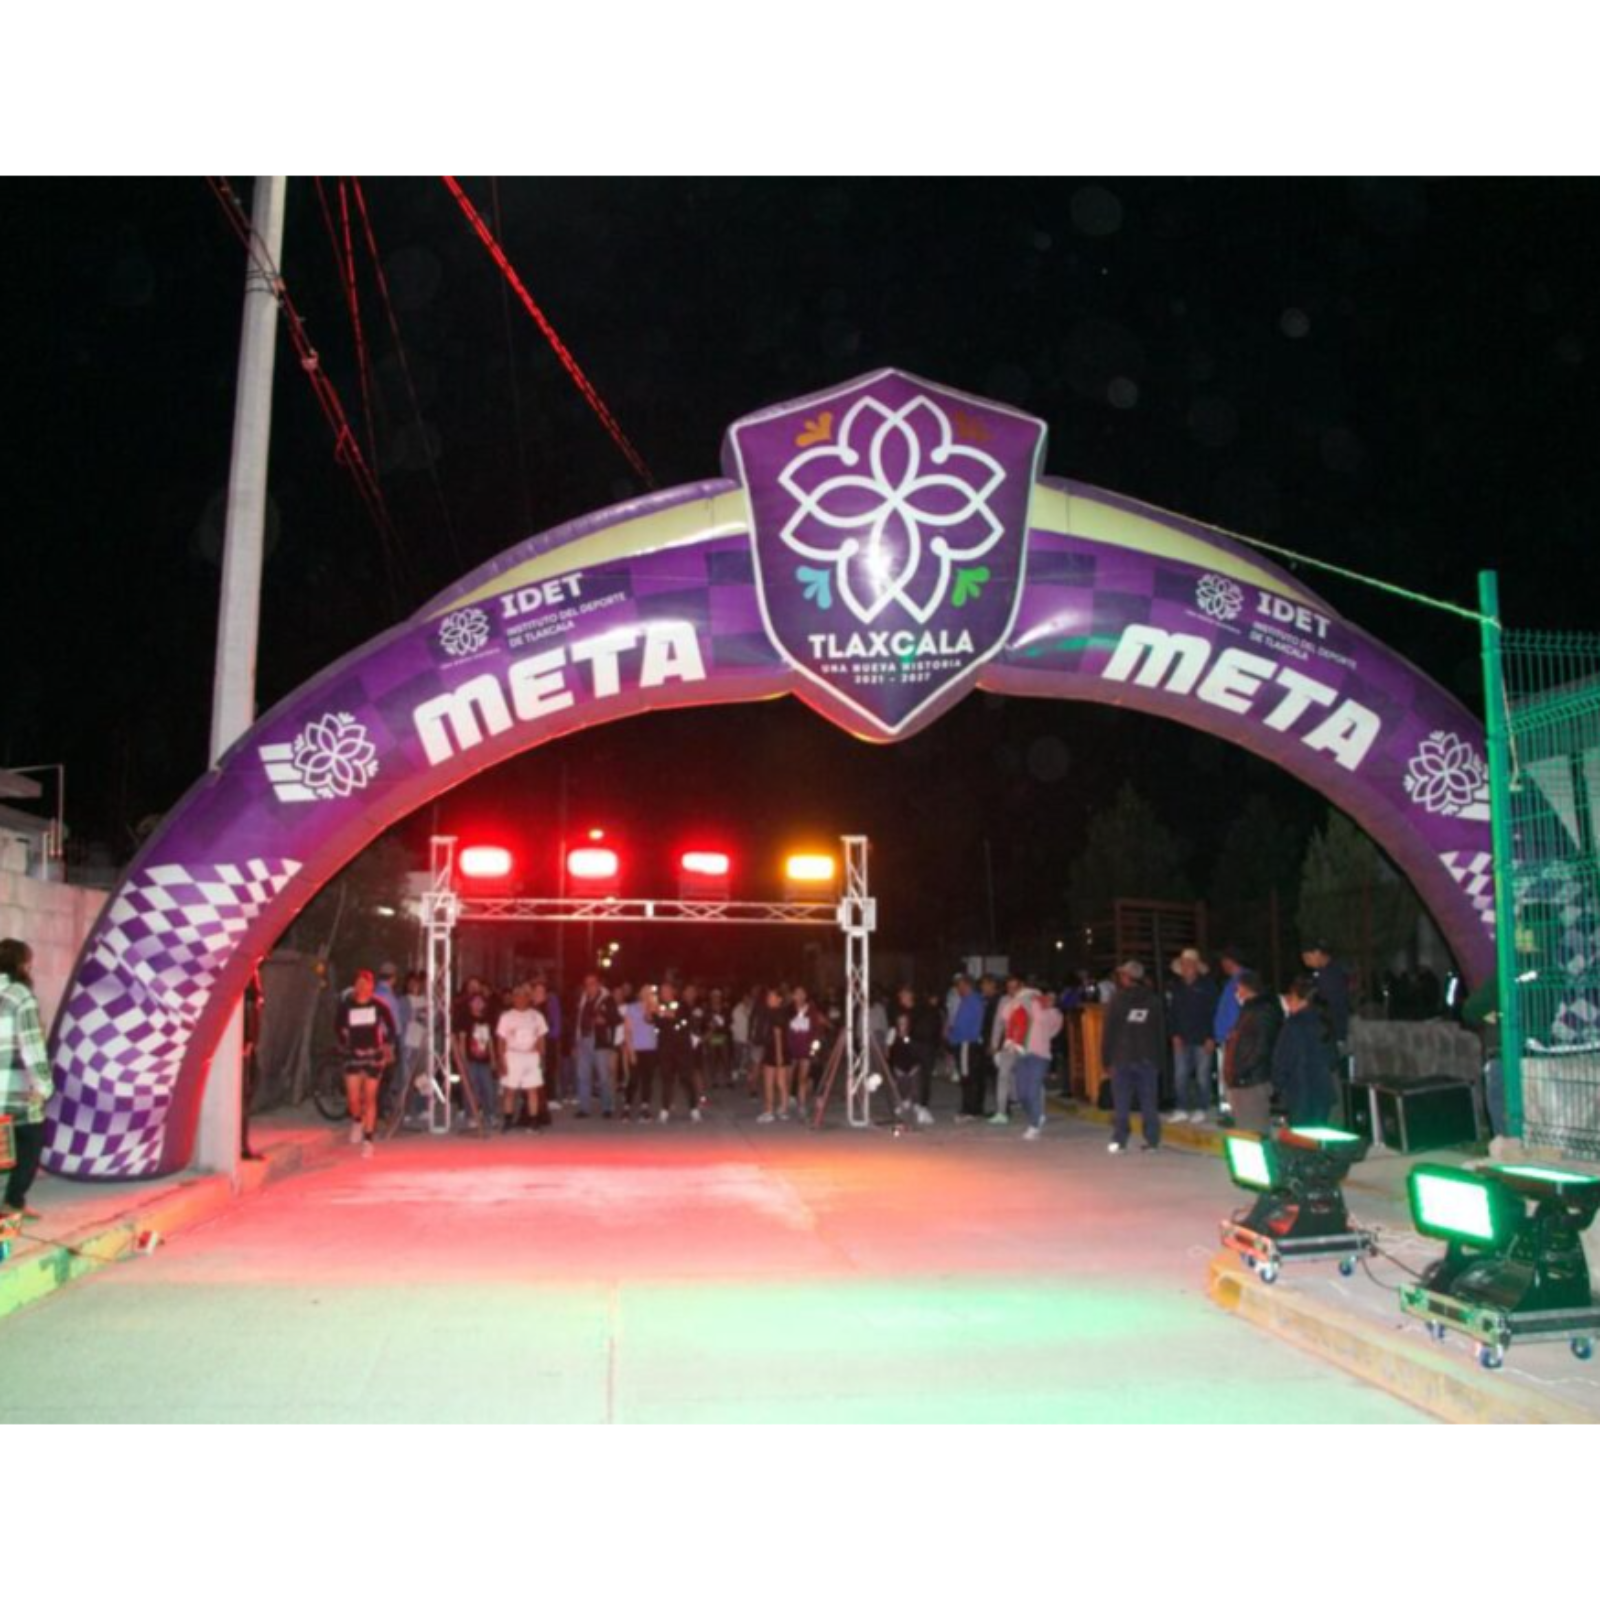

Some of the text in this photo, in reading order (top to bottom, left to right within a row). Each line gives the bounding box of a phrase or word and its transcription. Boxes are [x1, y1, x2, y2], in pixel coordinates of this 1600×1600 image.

[501, 572, 582, 618] IDET
[507, 591, 625, 636] INSTITUTO DEL DEPORTE
[1257, 592, 1330, 638] IDET
[509, 620, 575, 648] DE TLAXCALA
[808, 629, 974, 659] TLAXCALA
[821, 659, 960, 673] UNA NUEVA HISTORIA
[855, 675, 883, 684] 2021
[902, 672, 930, 683] 2027
[413, 619, 706, 766] META
[1102, 623, 1381, 771] META
